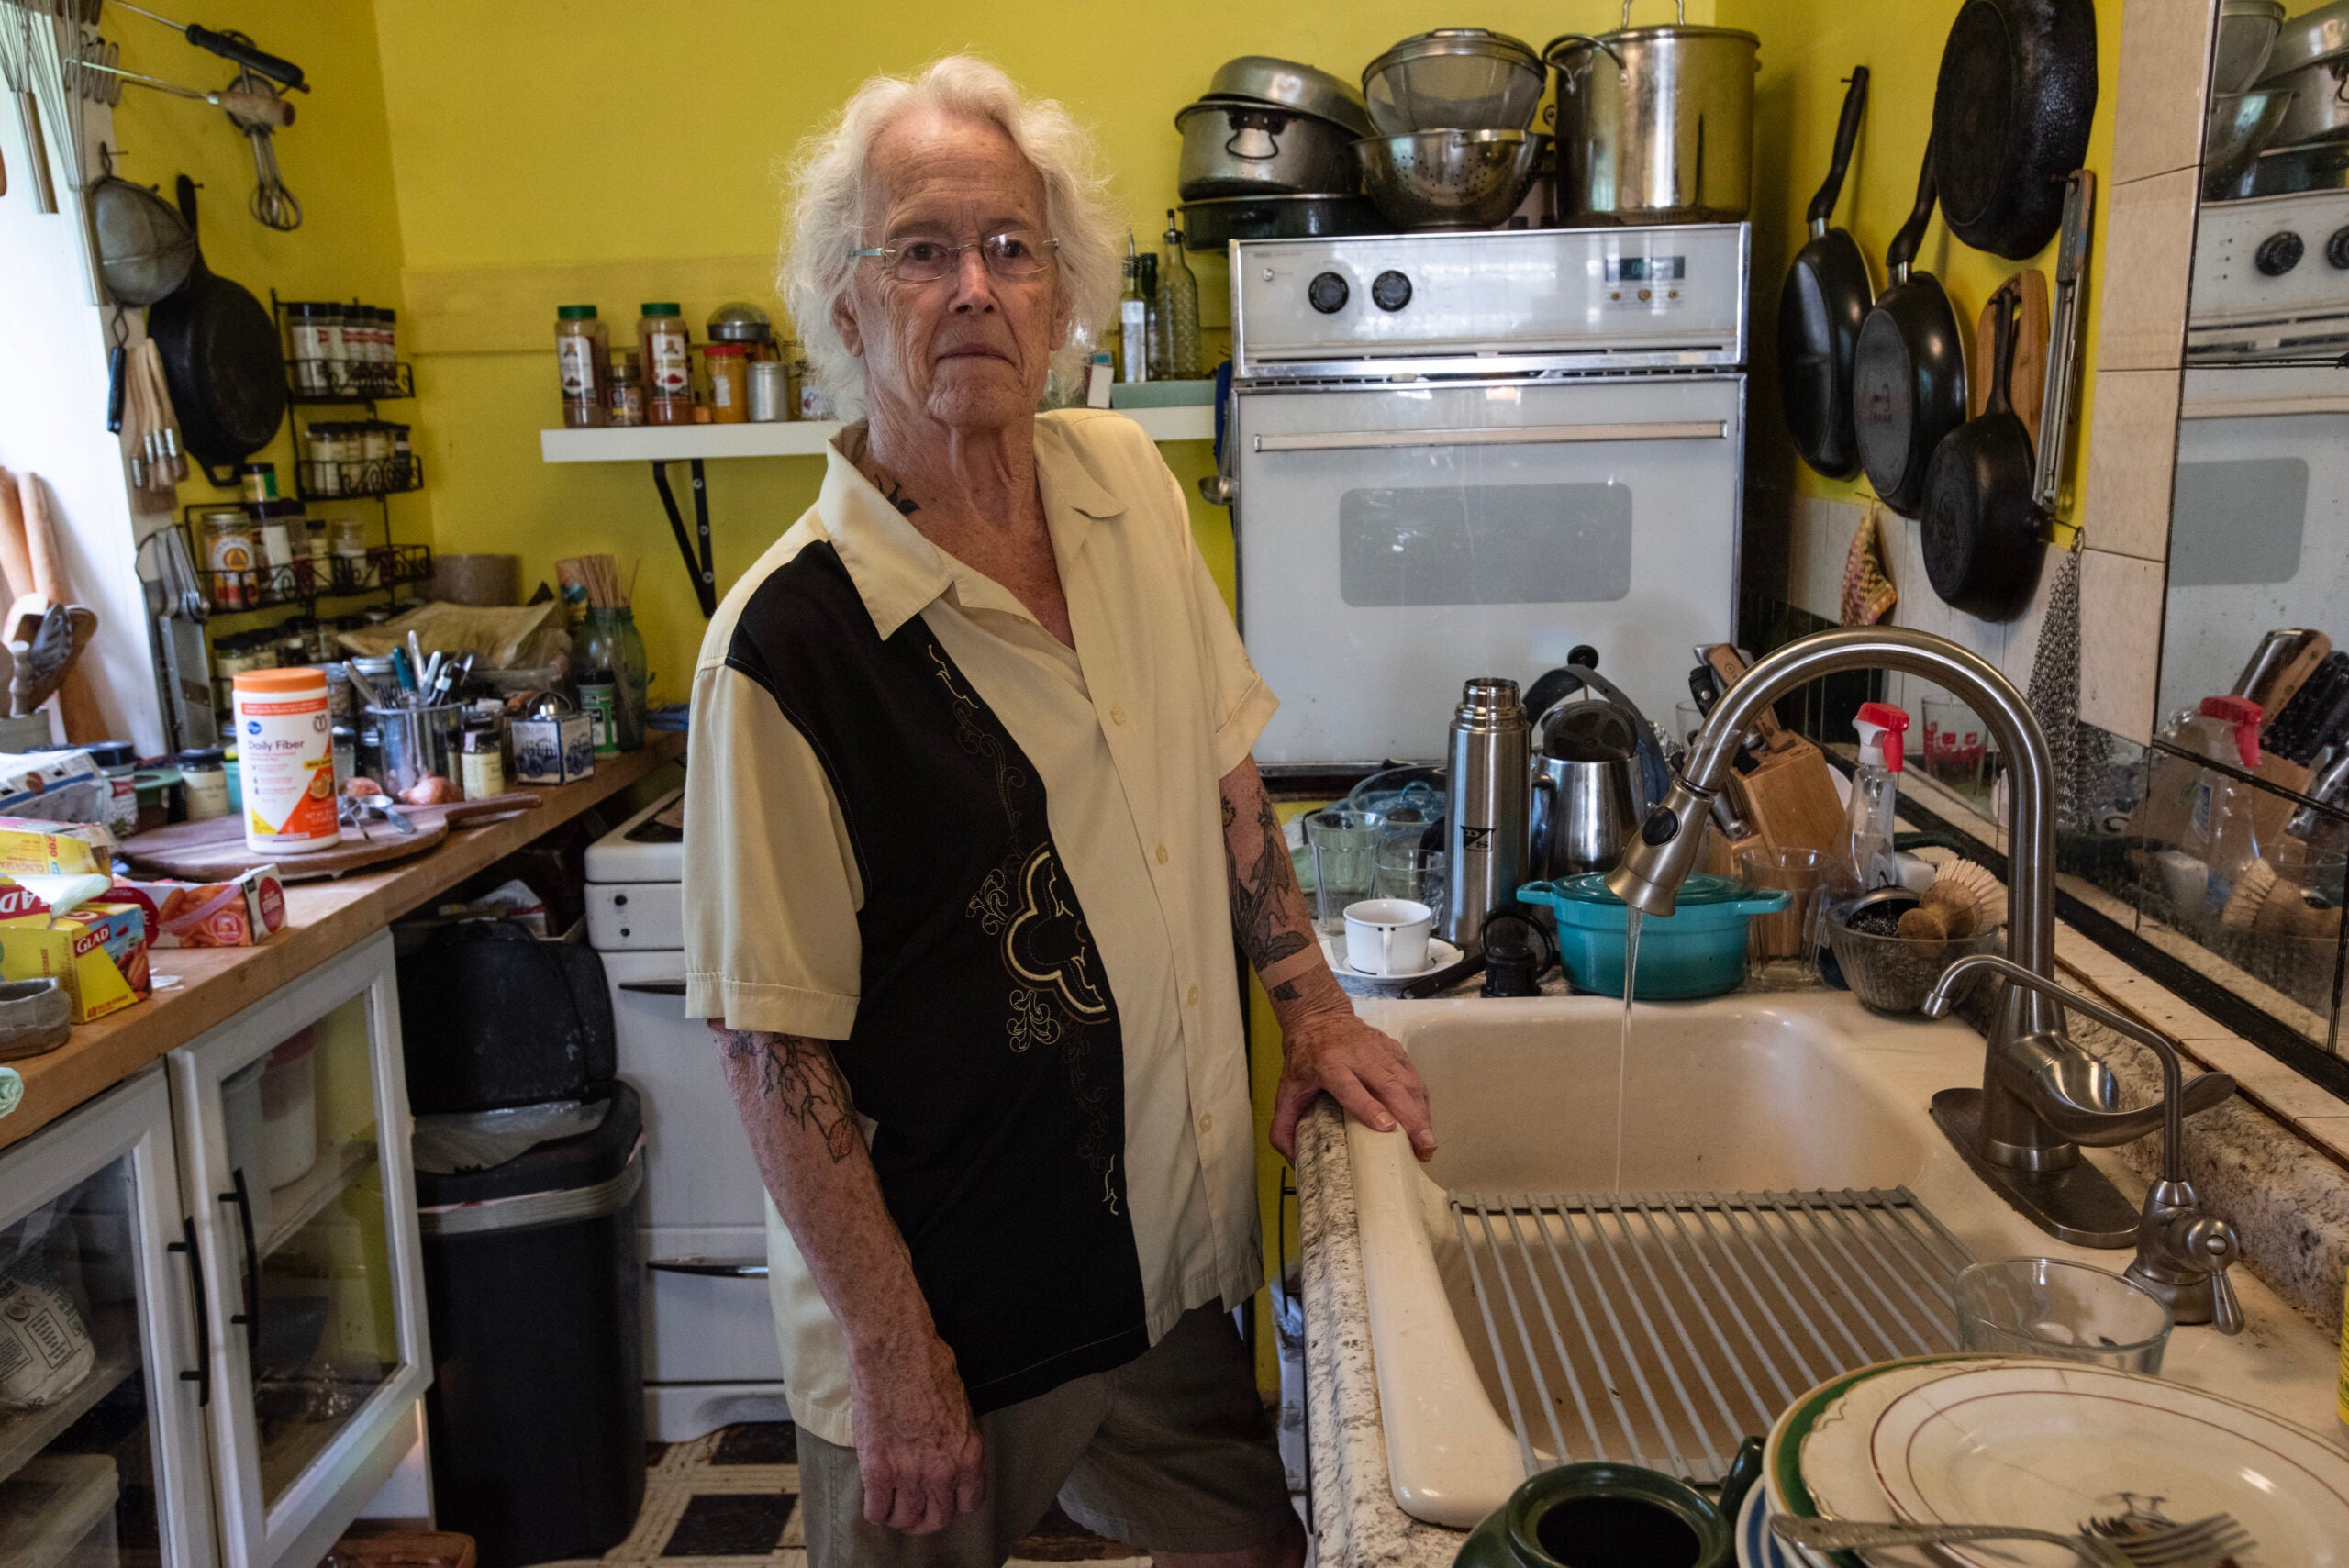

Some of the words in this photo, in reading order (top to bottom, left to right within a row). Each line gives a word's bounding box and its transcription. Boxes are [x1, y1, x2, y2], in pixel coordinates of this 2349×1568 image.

[248, 740, 272, 751] Daily
[276, 740, 305, 751] Fiber
[48, 835, 59, 857] 200
[76, 926, 110, 954] GLAD
[87, 1006, 97, 1019] 40
